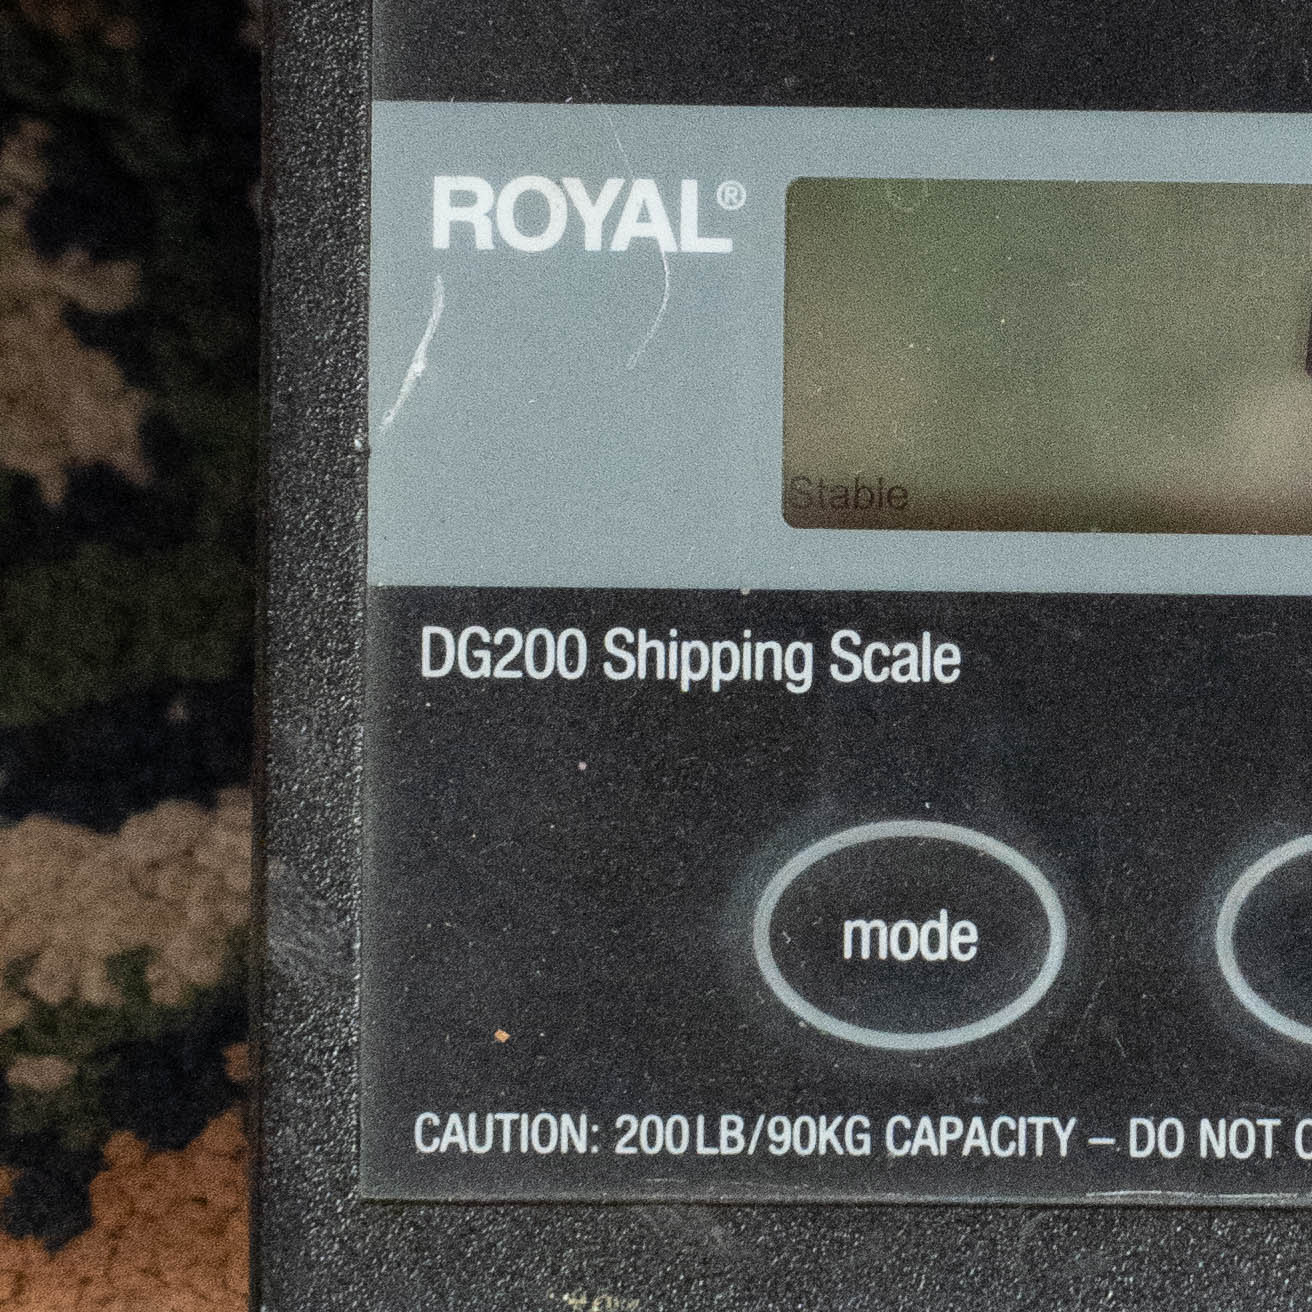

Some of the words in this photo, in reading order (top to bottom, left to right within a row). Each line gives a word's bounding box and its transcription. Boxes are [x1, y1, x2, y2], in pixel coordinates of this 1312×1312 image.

[787, 474, 910, 514] Stable
[421, 625, 587, 681] DG200
[602, 627, 814, 694] Shipping
[829, 628, 962, 684] Scale
[842, 908, 978, 962] mode
[414, 1113, 600, 1155] CAUTION:
[885, 1116, 1075, 1158] CAPACITY
[1129, 1118, 1184, 1159] DO
[1199, 1118, 1280, 1160] NOT
